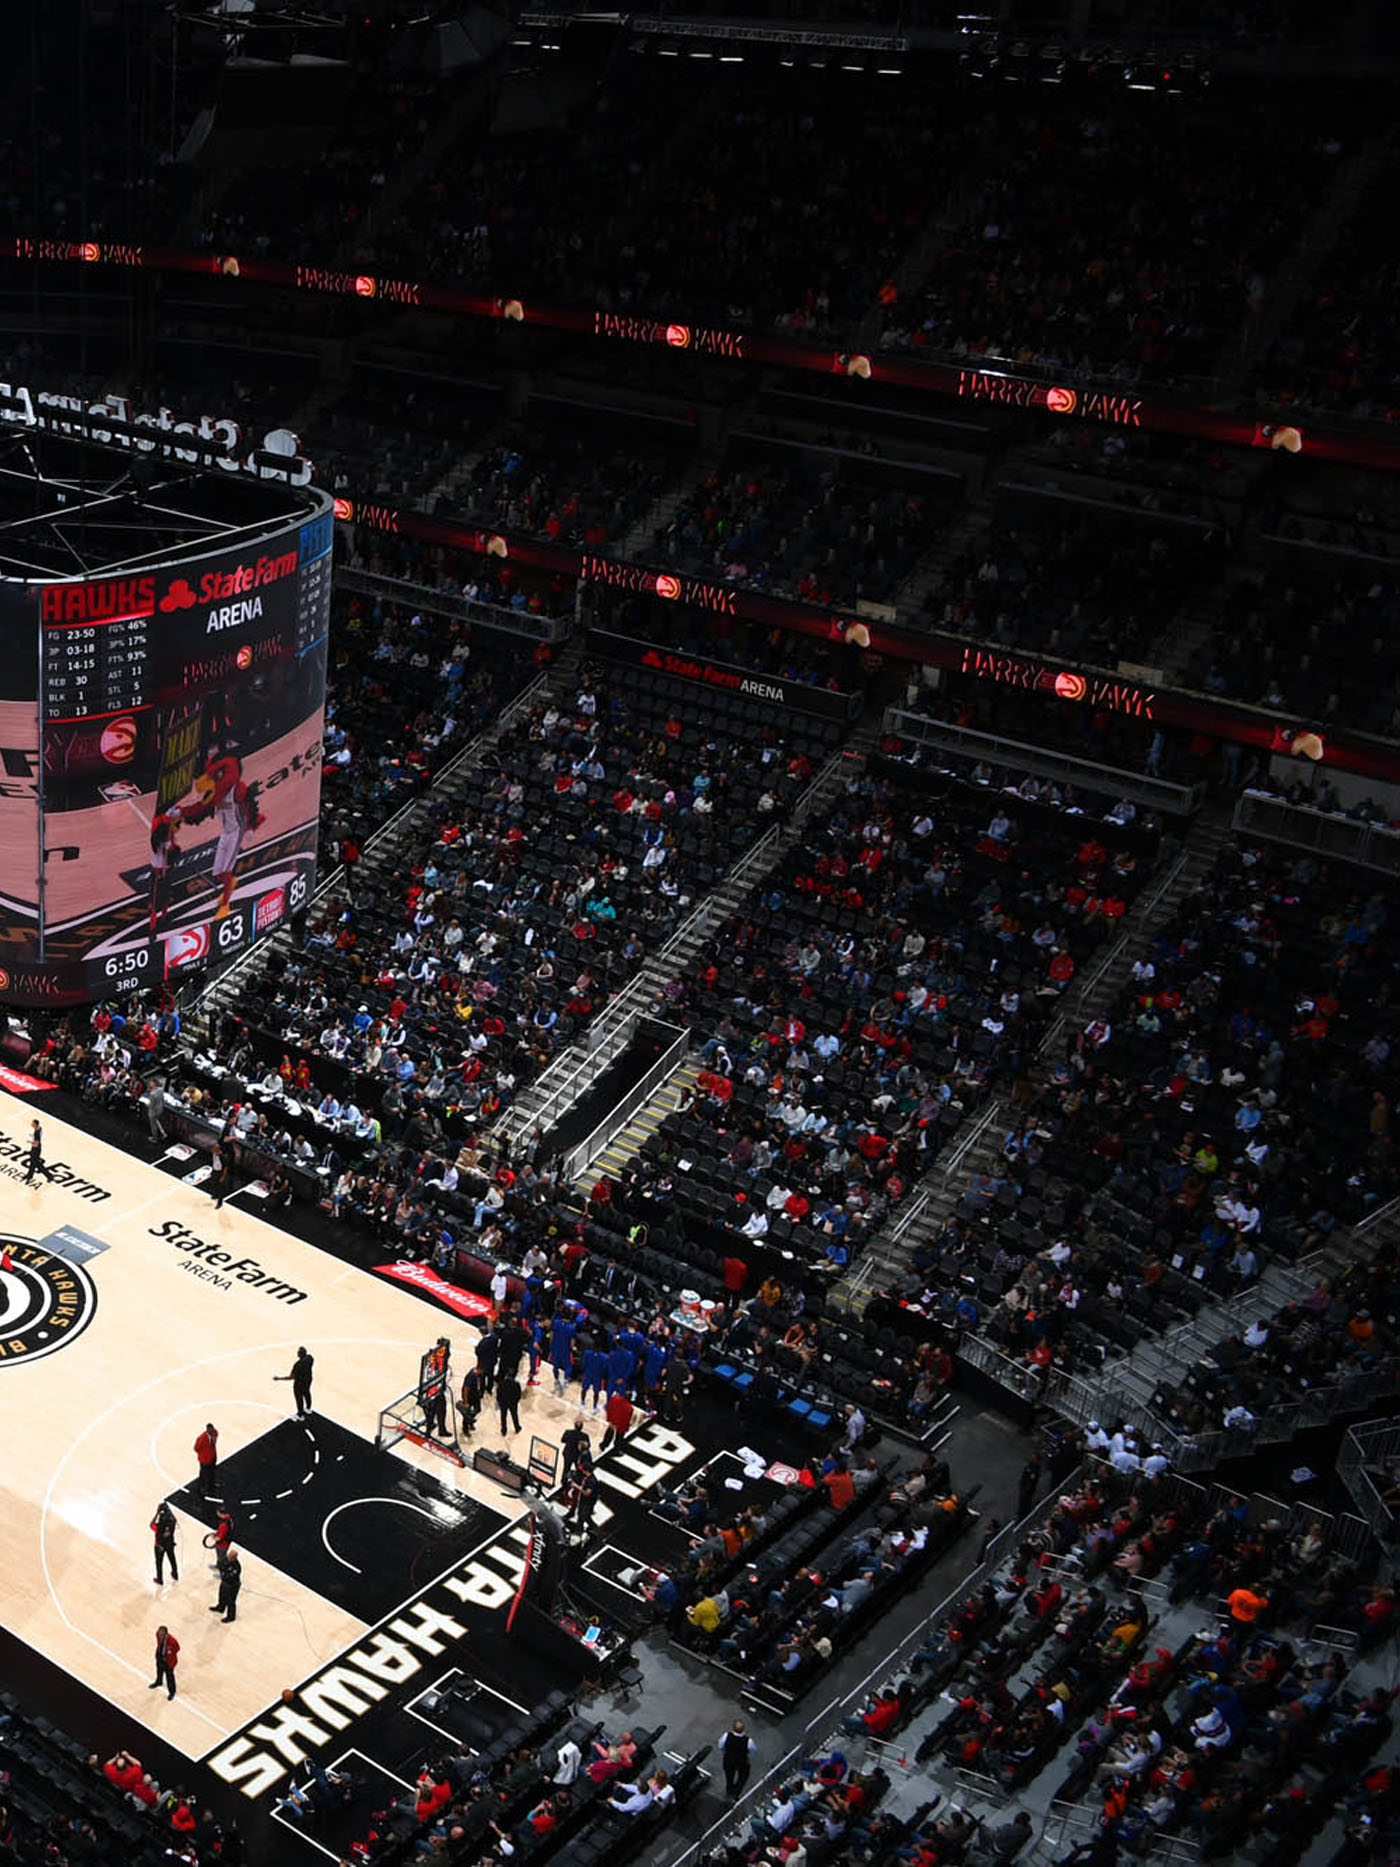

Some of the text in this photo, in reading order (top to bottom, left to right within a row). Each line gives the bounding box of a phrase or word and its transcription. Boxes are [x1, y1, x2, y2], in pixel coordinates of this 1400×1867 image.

[42, 577, 155, 621] HAWKS
[207, 596, 263, 634] ARENA
[127, 619, 147, 630] 46%
[48, 628, 95, 640] FG 23-50
[128, 635, 147, 646] 17%
[67, 643, 95, 656] 03-18
[127, 651, 147, 662] 93%
[48, 659, 95, 671] FT 14-15
[75, 675, 88, 686] 30
[108, 666, 142, 680] AST 11
[134, 681, 140, 691] 5
[740, 679, 785, 702] ARENA
[79, 691, 84, 700] 1
[132, 696, 142, 706] 12
[48, 706, 88, 717] TO 13
[290, 873, 306, 906] 85
[218, 915, 244, 946] 63
[105, 950, 149, 976] 6:50
[115, 977, 139, 993] 3RD
[178, 1259, 233, 1292] ARENA
[392, 1260, 489, 1313] Budweiser
[49, 1268, 78, 1328] HAWKS
[529, 1529, 545, 1573] xfinity
[206, 1600, 469, 1800] HAWKS
